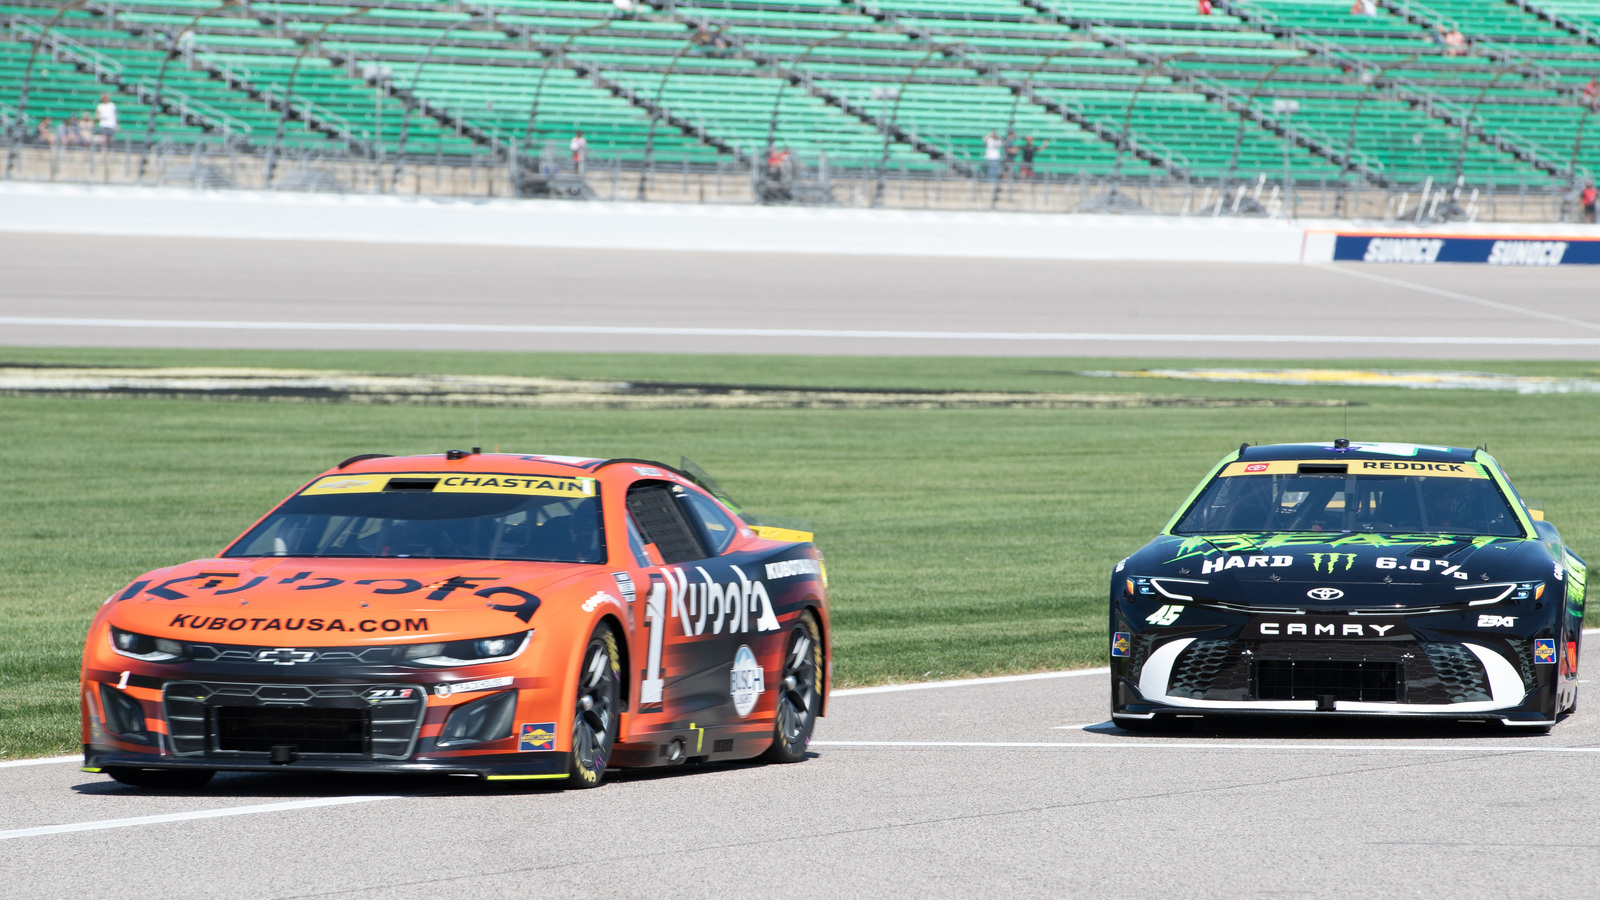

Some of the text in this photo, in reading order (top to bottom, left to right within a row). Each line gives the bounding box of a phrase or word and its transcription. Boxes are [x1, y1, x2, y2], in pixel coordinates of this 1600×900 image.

[1363, 237, 1444, 263] SUNOCO
[1487, 240, 1568, 266] SUNOCO
[1363, 461, 1465, 473] REDDICK
[443, 477, 583, 492] CHASTAIN
[1201, 555, 1468, 580] HARD 6.0%
[660, 565, 781, 637] Kubota
[169, 613, 429, 632] KUBOTAUSA.COM
[1145, 604, 1185, 626] 45
[1260, 623, 1395, 636] CAMRY
[641, 583, 667, 704] 1
[117, 670, 131, 690] 1
[731, 669, 764, 694] BUSCH
[368, 688, 413, 699] ZL1
